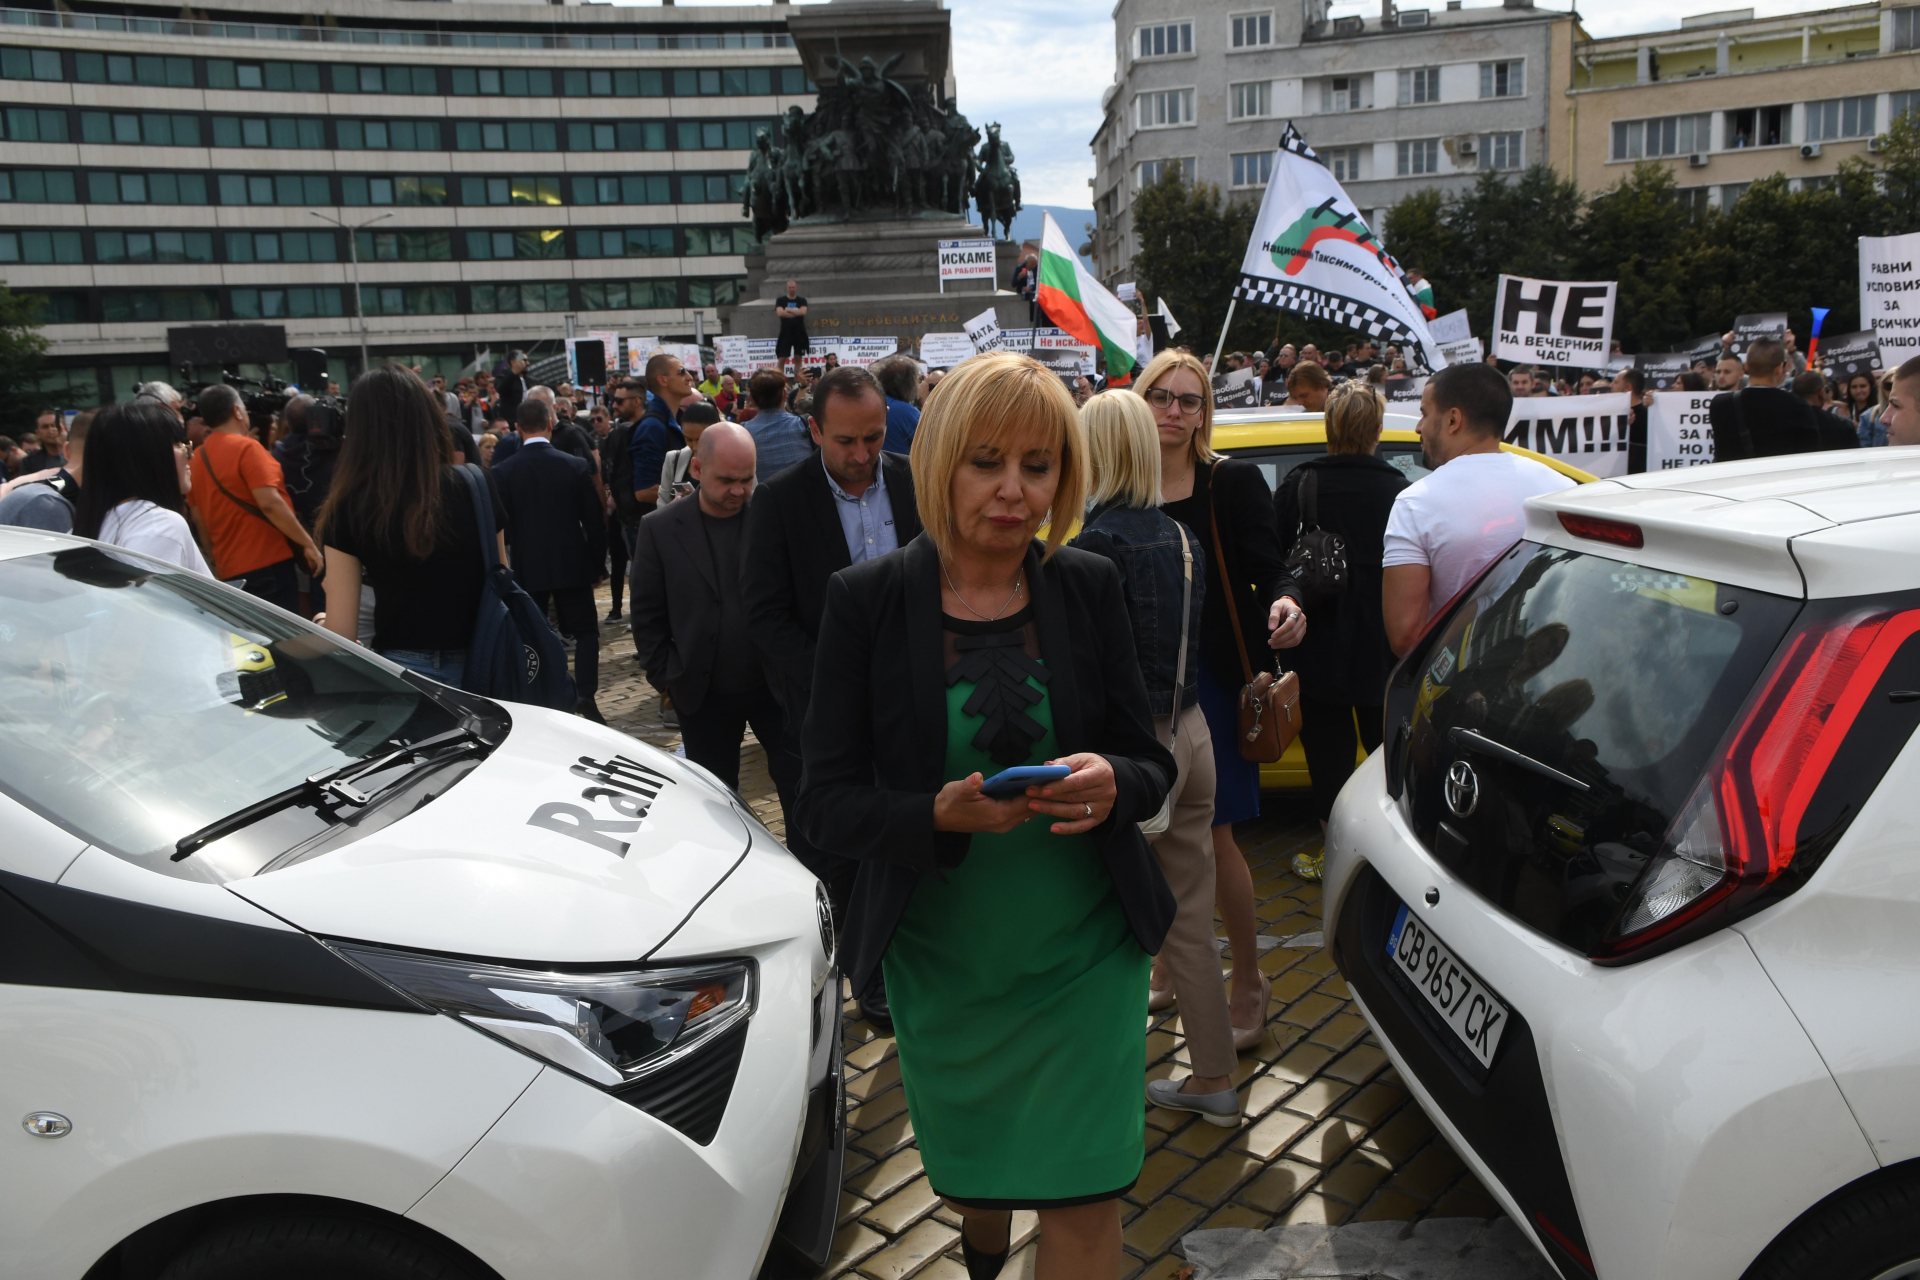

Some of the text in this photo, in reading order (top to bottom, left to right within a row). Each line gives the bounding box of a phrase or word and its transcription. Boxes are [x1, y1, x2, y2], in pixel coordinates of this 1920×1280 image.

[941, 252, 993, 264] ИСКАМЕ
[1871, 261, 1912, 274] РАВНИ
[1866, 279, 1920, 292] УСЛОВИЯ
[1501, 279, 1608, 339] НЕ
[1884, 301, 1900, 311] ЗА
[813, 318, 840, 328] АРЮ
[969, 323, 995, 343] НАТА
[978, 334, 1002, 353] ИЗБО
[1041, 338, 1052, 347] Не
[1500, 332, 1603, 352] НА ВЕЧЕРНИЯ
[1878, 336, 1920, 347] АНШО
[1536, 349, 1570, 362] ЧАС!
[1839, 351, 1876, 363] Бизнеса
[1040, 360, 1074, 368] свобода
[1212, 383, 1245, 395] свобода
[1217, 389, 1251, 403] Бизнеса
[1679, 429, 1700, 440] ЗА
[1679, 444, 1703, 455] НО
[1662, 459, 1684, 470] НЕ
[1389, 934, 1398, 949] BG
[1421, 945, 1472, 1018] 9657
